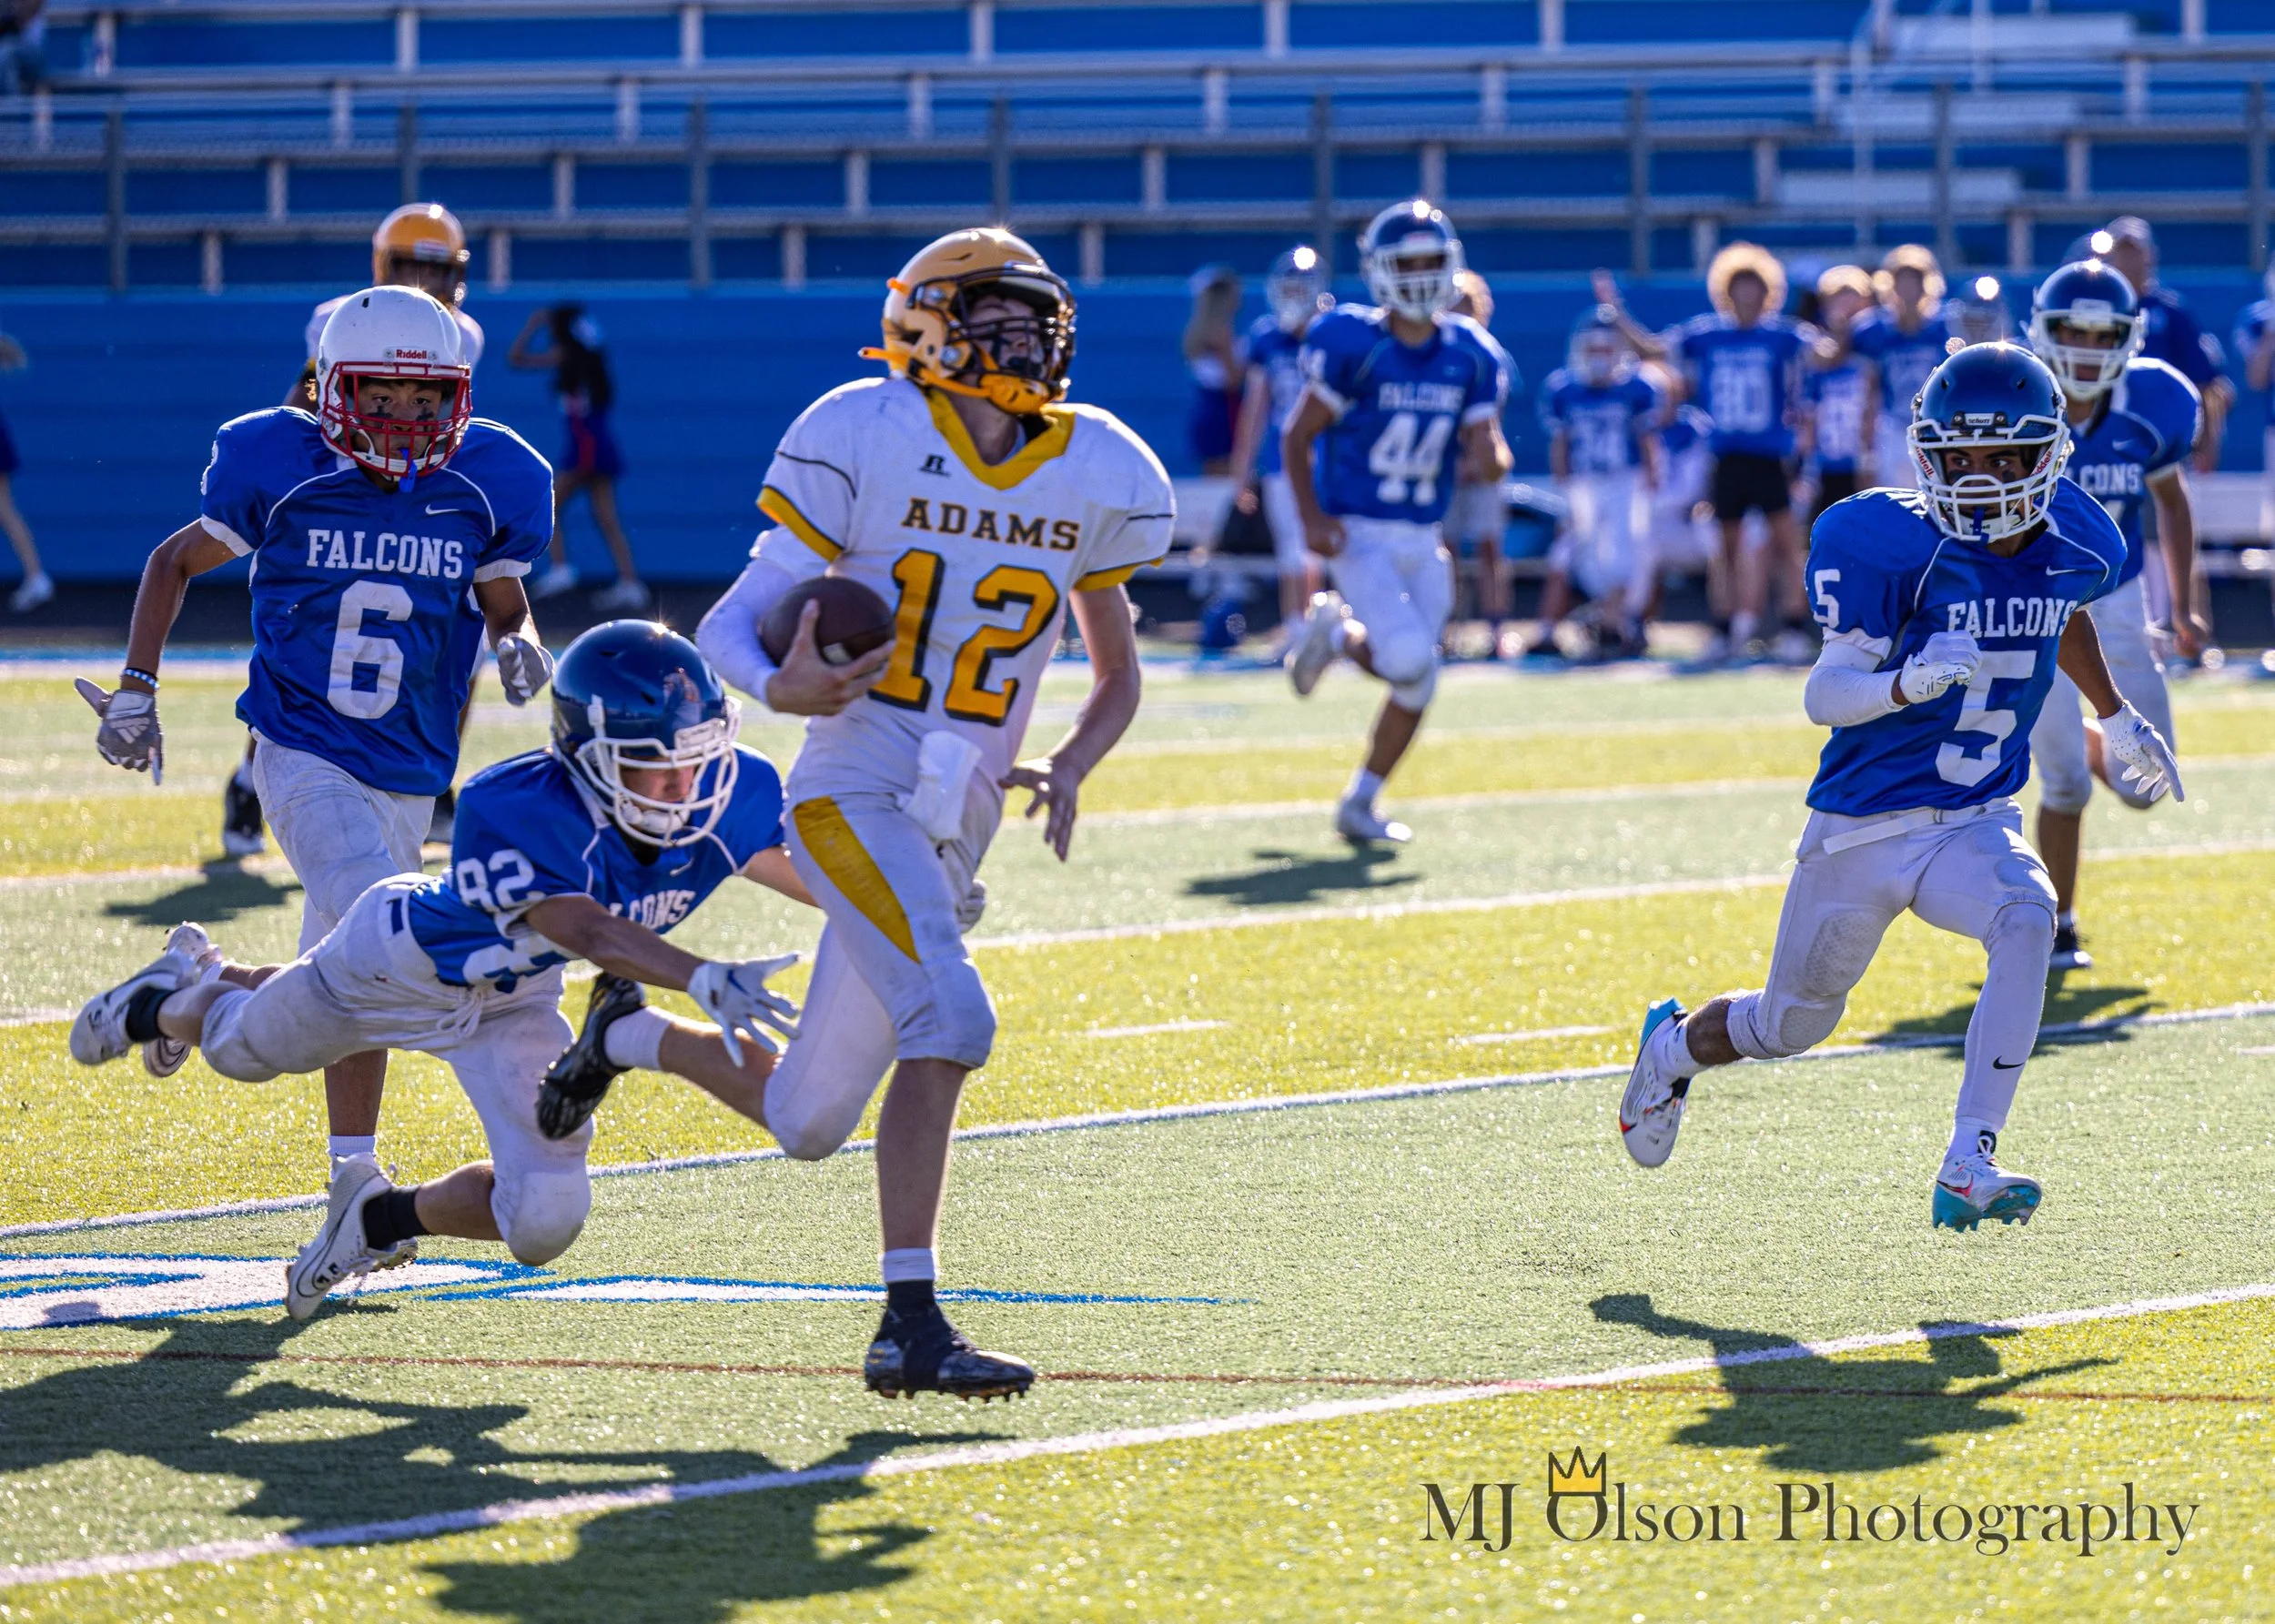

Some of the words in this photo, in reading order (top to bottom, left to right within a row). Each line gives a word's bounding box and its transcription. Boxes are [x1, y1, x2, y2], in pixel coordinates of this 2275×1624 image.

[395, 348, 428, 359] Riddell
[1368, 412, 1456, 507] 44
[307, 529, 463, 580] FALCONS
[901, 498, 1080, 552] ADAMS
[1814, 569, 1840, 629] 5
[1947, 597, 2078, 639] FALCONS
[327, 580, 413, 720] 6
[867, 547, 1059, 727] 12
[1936, 650, 2037, 788] 5
[455, 848, 547, 914] 82
